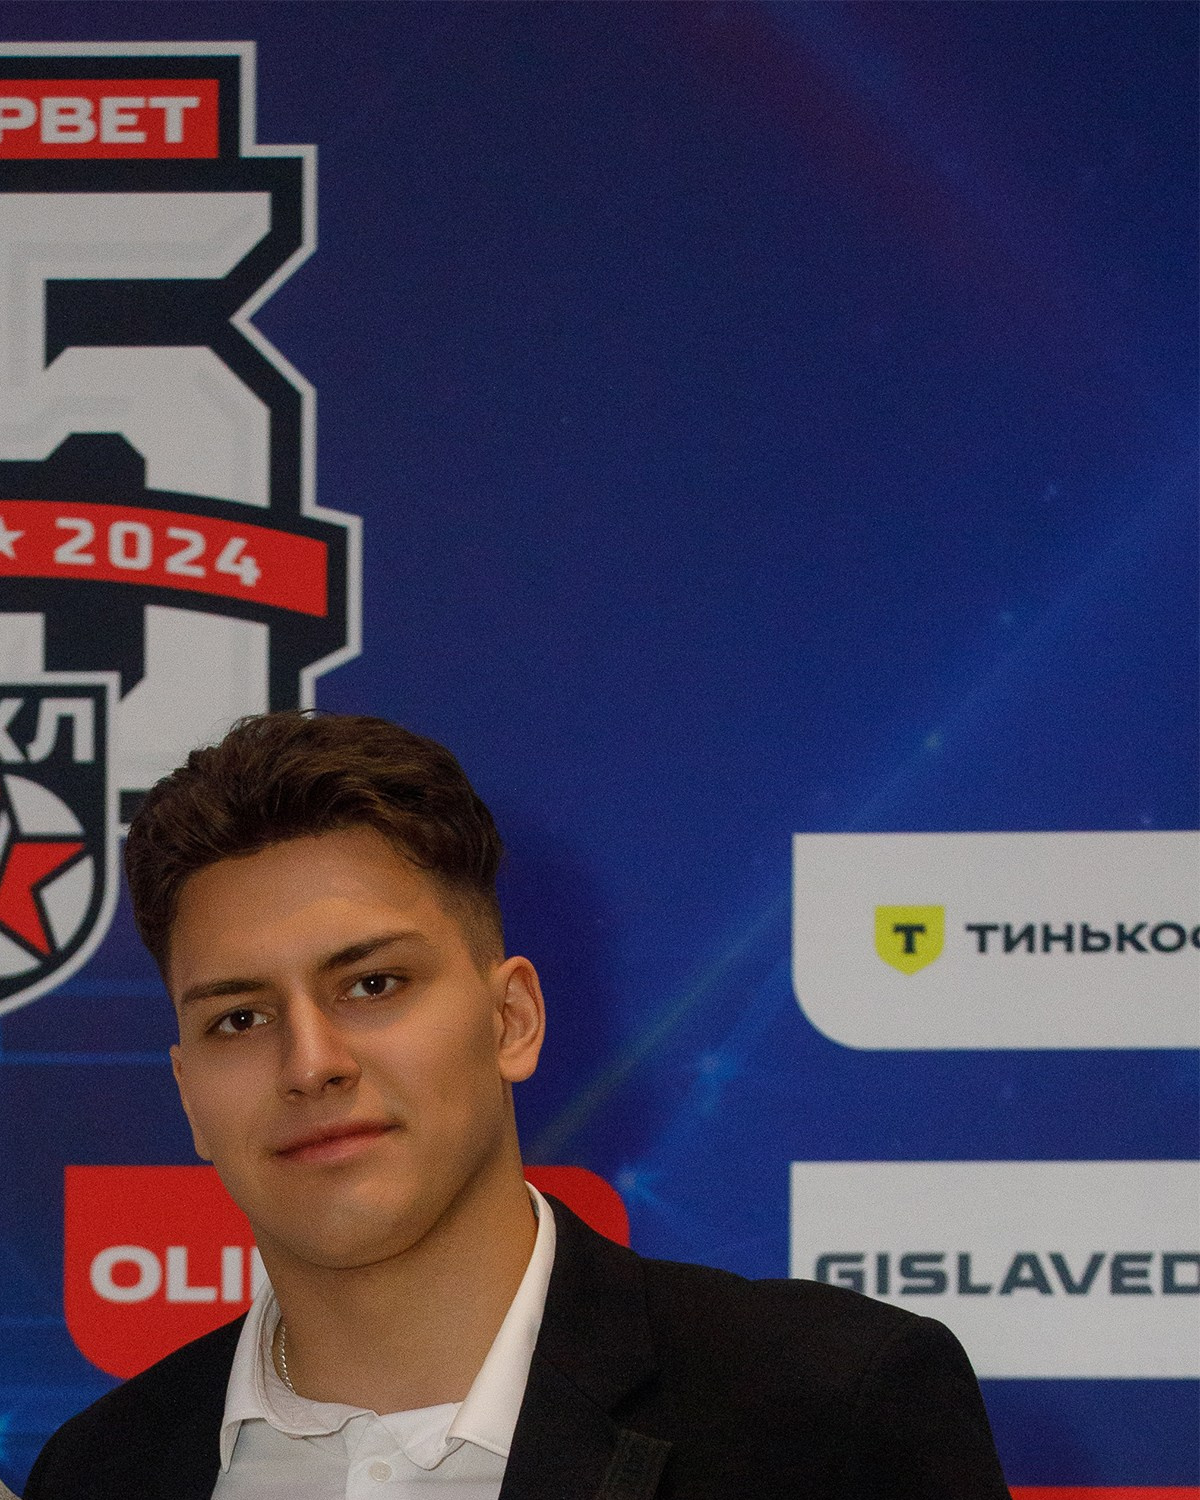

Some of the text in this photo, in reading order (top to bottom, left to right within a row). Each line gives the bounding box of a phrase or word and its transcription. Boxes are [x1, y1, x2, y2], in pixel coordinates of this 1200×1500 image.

[52, 516, 262, 588] 2024
[964, 922, 1200, 954] ТИНЬКО
[89, 1245, 270, 1304] OLI
[815, 1252, 1200, 1297] GISLAVED
